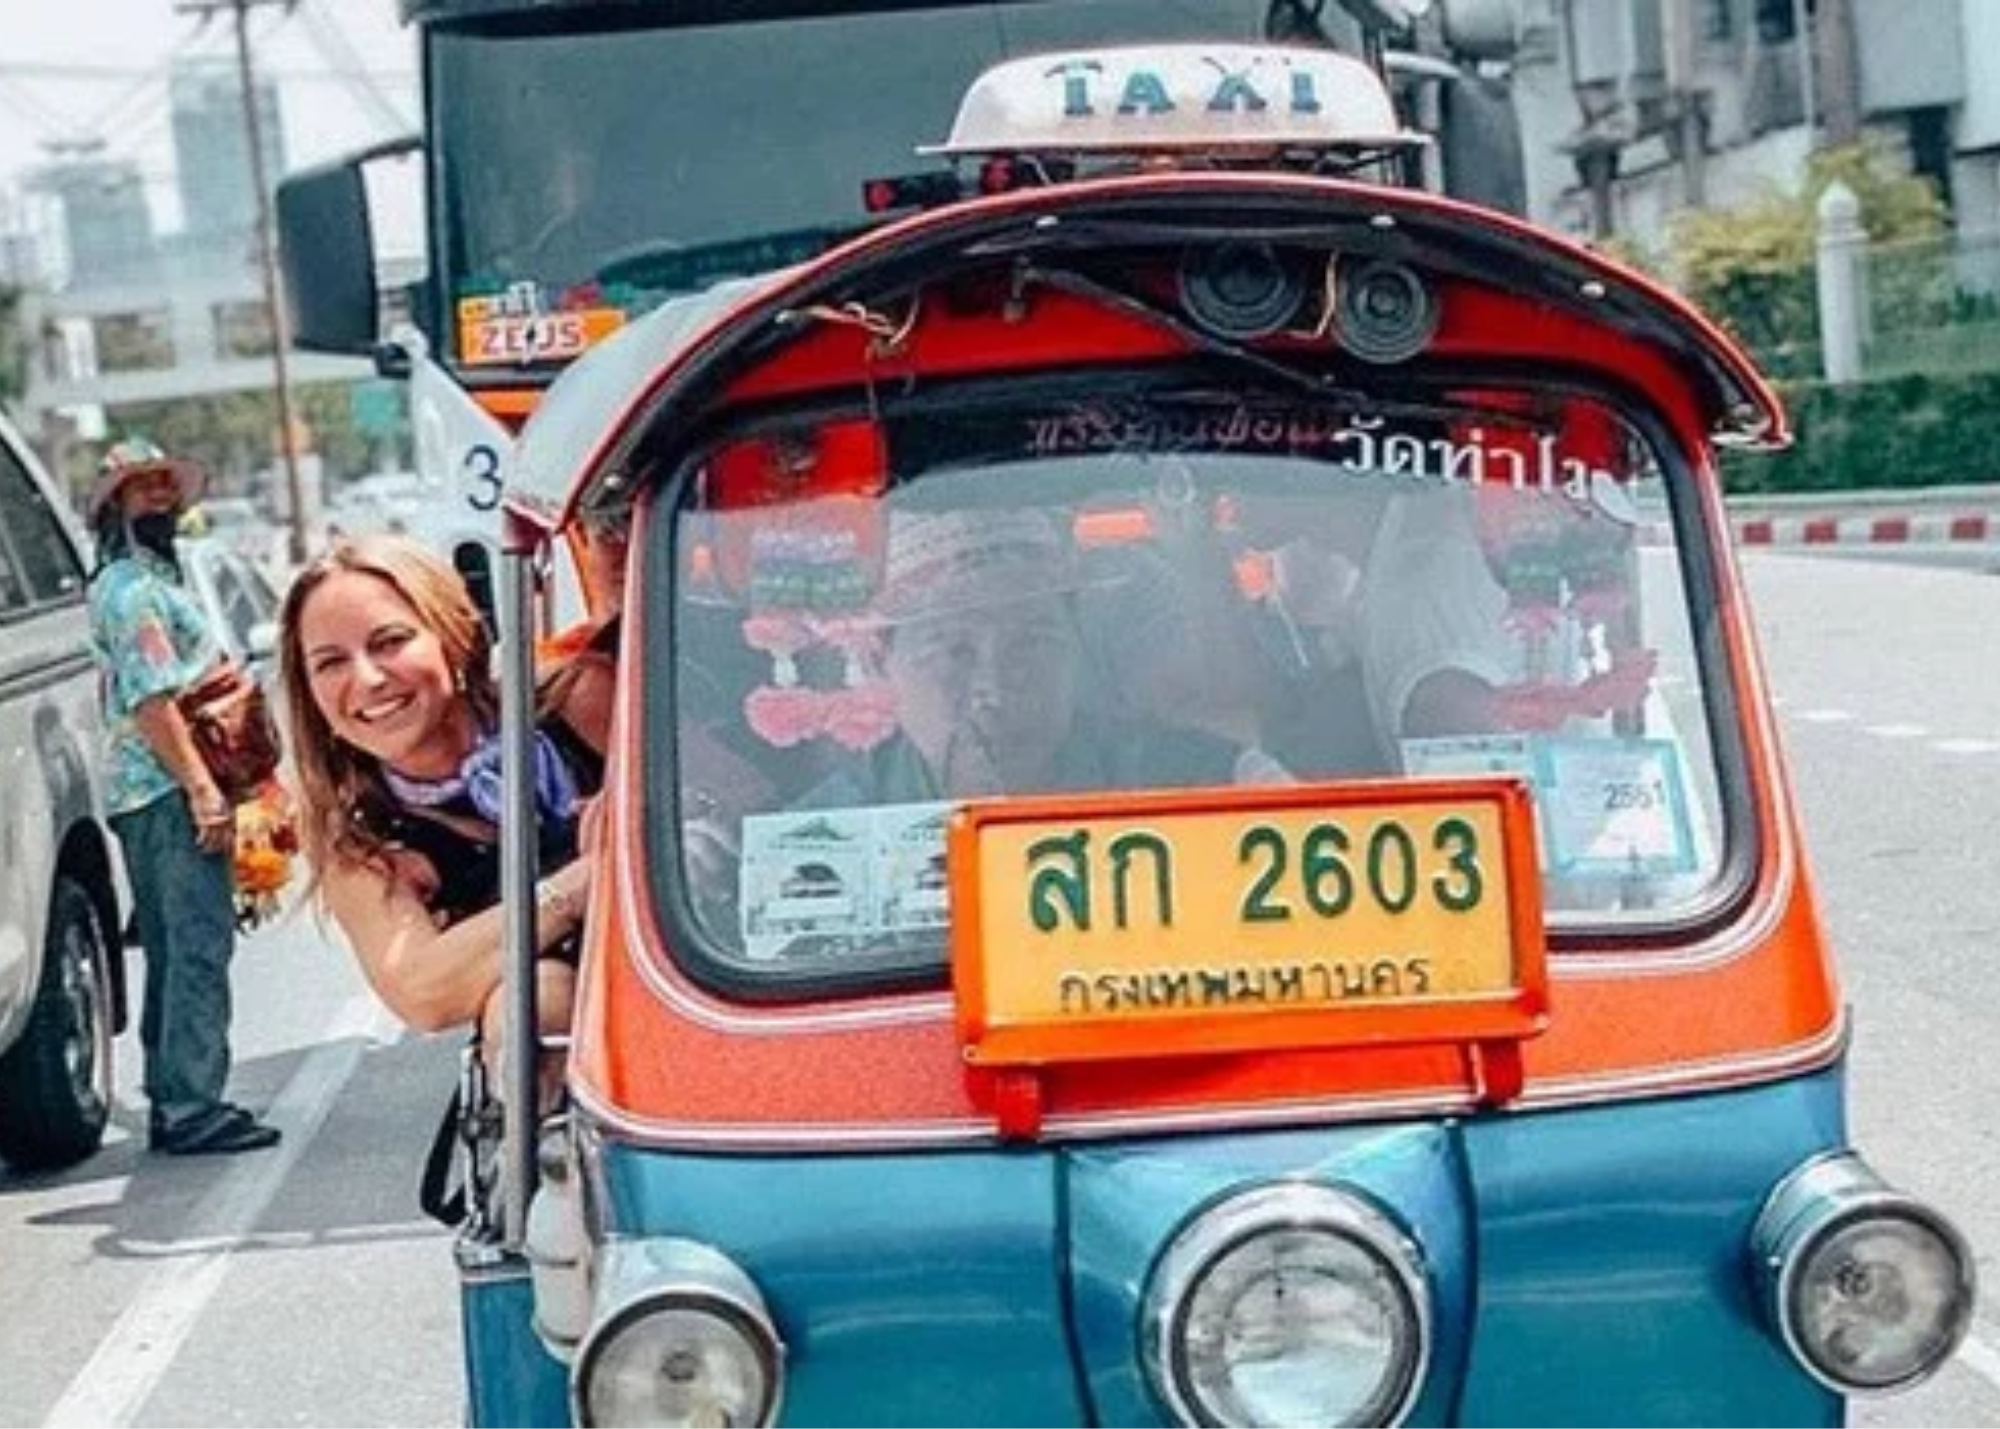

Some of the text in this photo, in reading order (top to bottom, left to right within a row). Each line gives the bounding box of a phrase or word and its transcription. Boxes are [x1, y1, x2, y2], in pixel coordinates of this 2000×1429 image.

[1044, 56, 1322, 116] TAXI
[464, 443, 504, 511] 3
[1025, 817, 1485, 933] สก 2603
